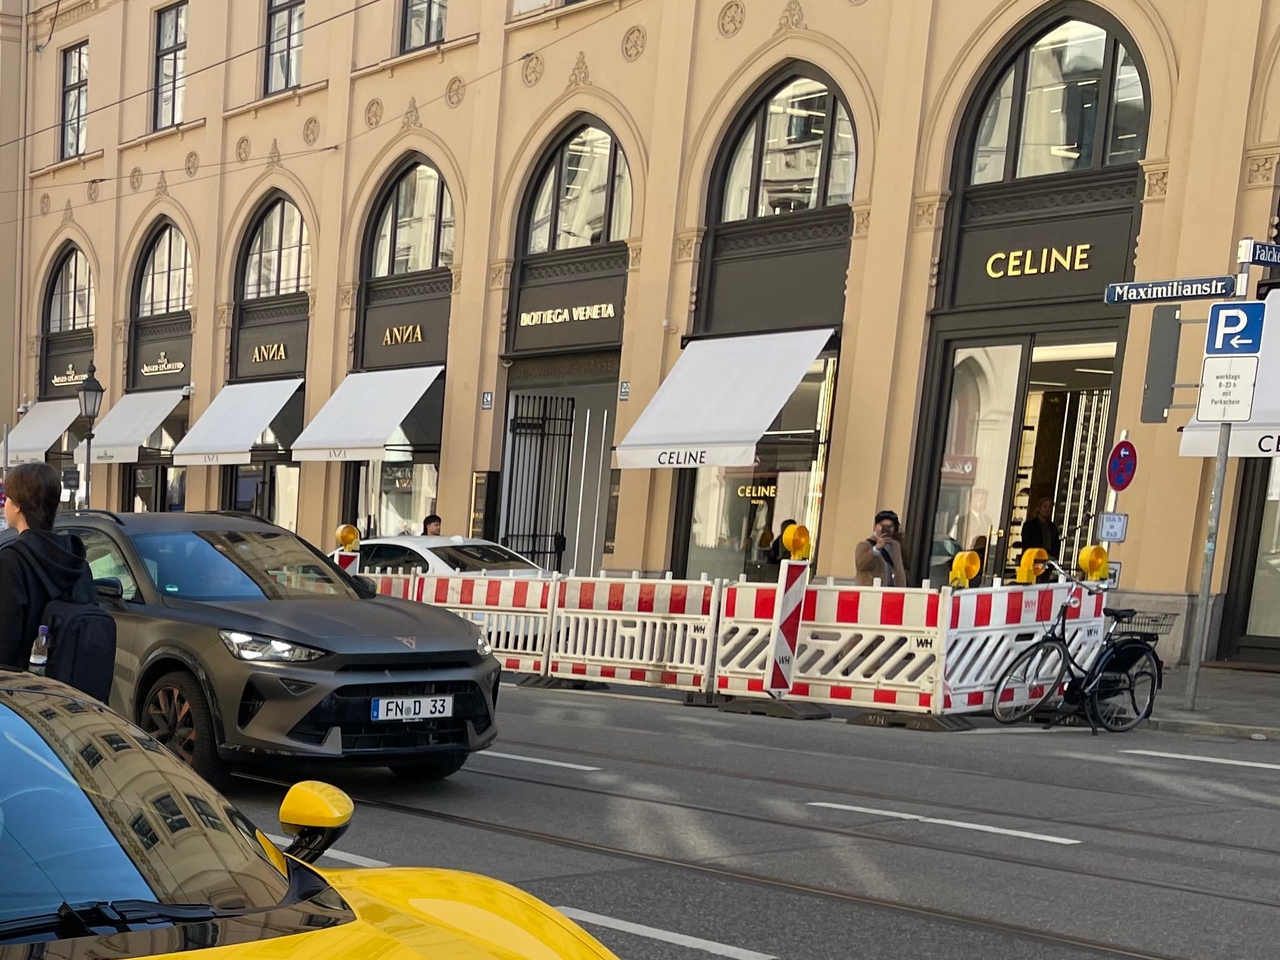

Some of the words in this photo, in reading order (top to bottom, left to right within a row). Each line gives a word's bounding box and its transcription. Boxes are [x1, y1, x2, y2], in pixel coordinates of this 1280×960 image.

[986, 243, 1091, 278] CELINE
[1114, 280, 1227, 302] Maximilianstr.
[520, 308, 570, 326] BOTTEGA
[572, 303, 615, 320] VENETA
[1214, 309, 1248, 349] P
[483, 393, 491, 402] 24
[658, 450, 706, 465] CELINE
[737, 485, 777, 497] CELINE
[1024, 599, 1036, 609] WH
[693, 624, 706, 635] WH
[1086, 628, 1099, 637] WH
[916, 639, 933, 648] WH
[778, 656, 790, 665] WH
[386, 700, 404, 717] FN
[413, 700, 421, 716] D
[429, 698, 446, 715] 33
